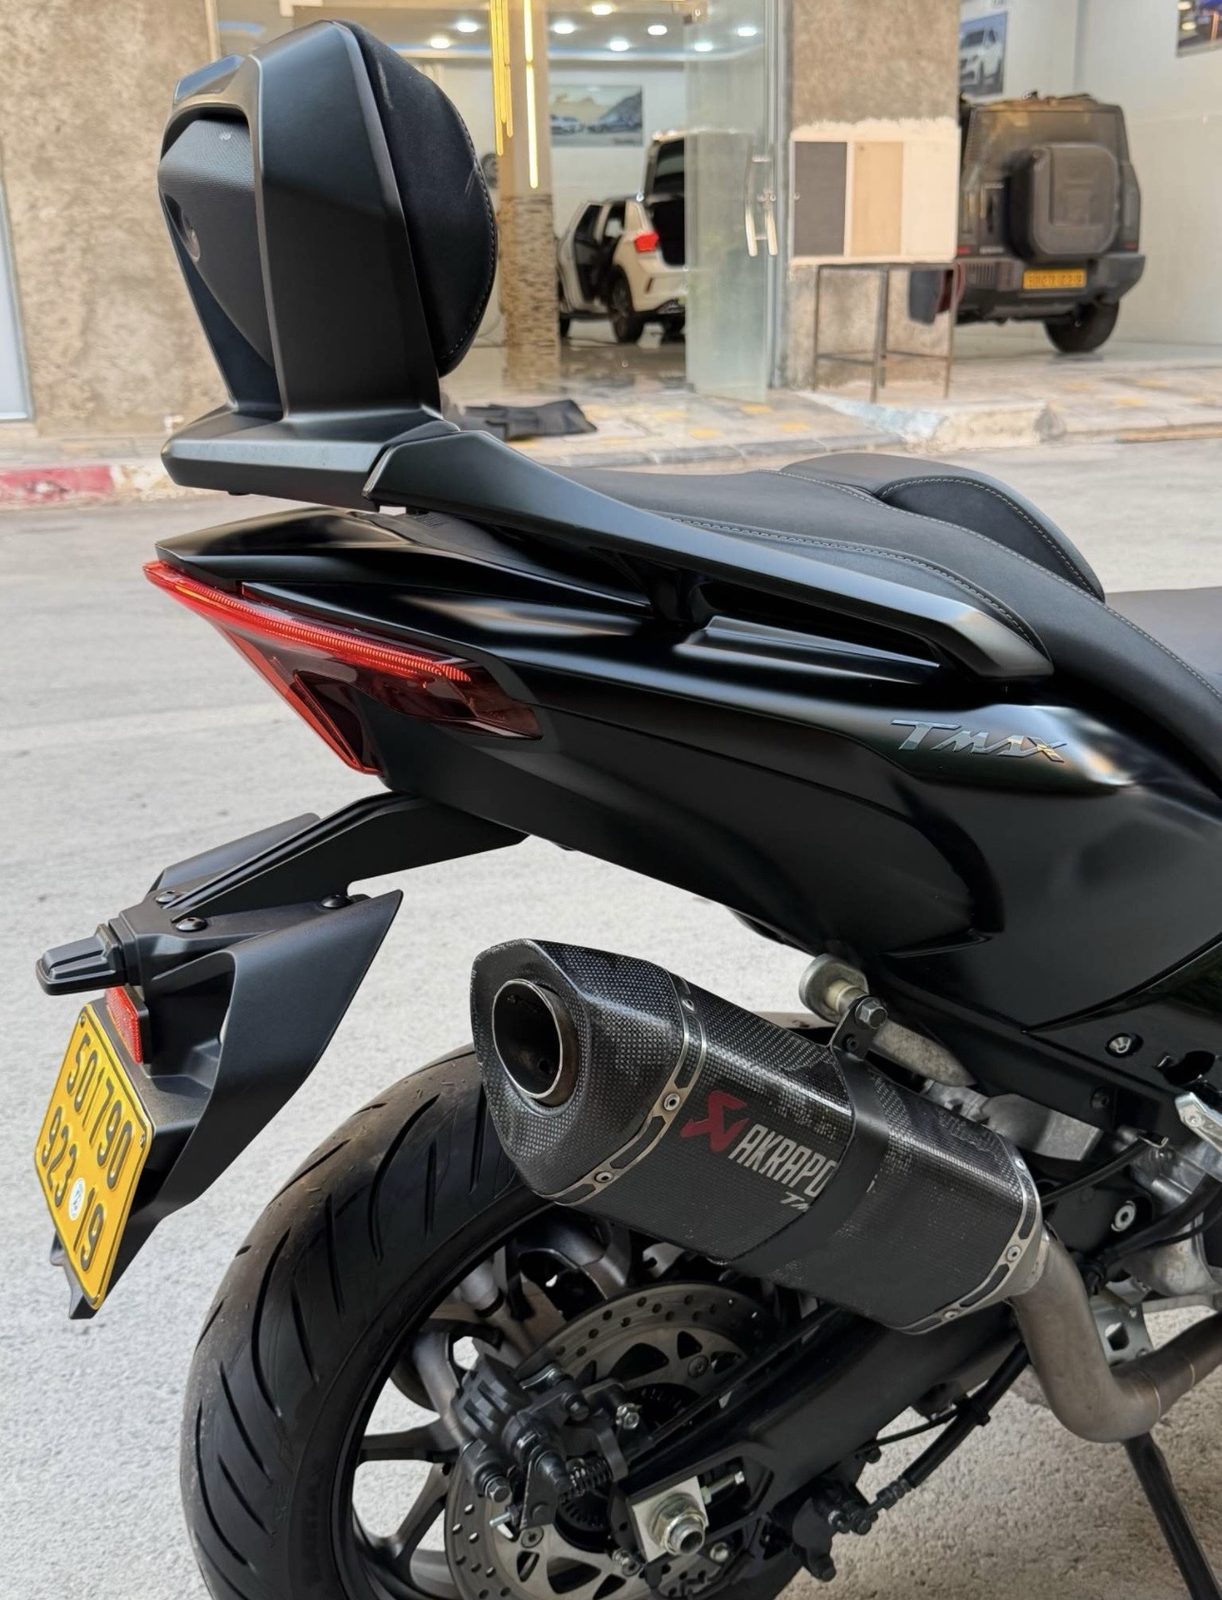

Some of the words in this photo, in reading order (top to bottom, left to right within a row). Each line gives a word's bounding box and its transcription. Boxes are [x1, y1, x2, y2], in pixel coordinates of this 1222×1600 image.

[891, 719, 1066, 763] TMAX
[43, 1107, 78, 1208] 923
[75, 1187, 105, 1271] 19
[66, 1033, 132, 1190] 501790
